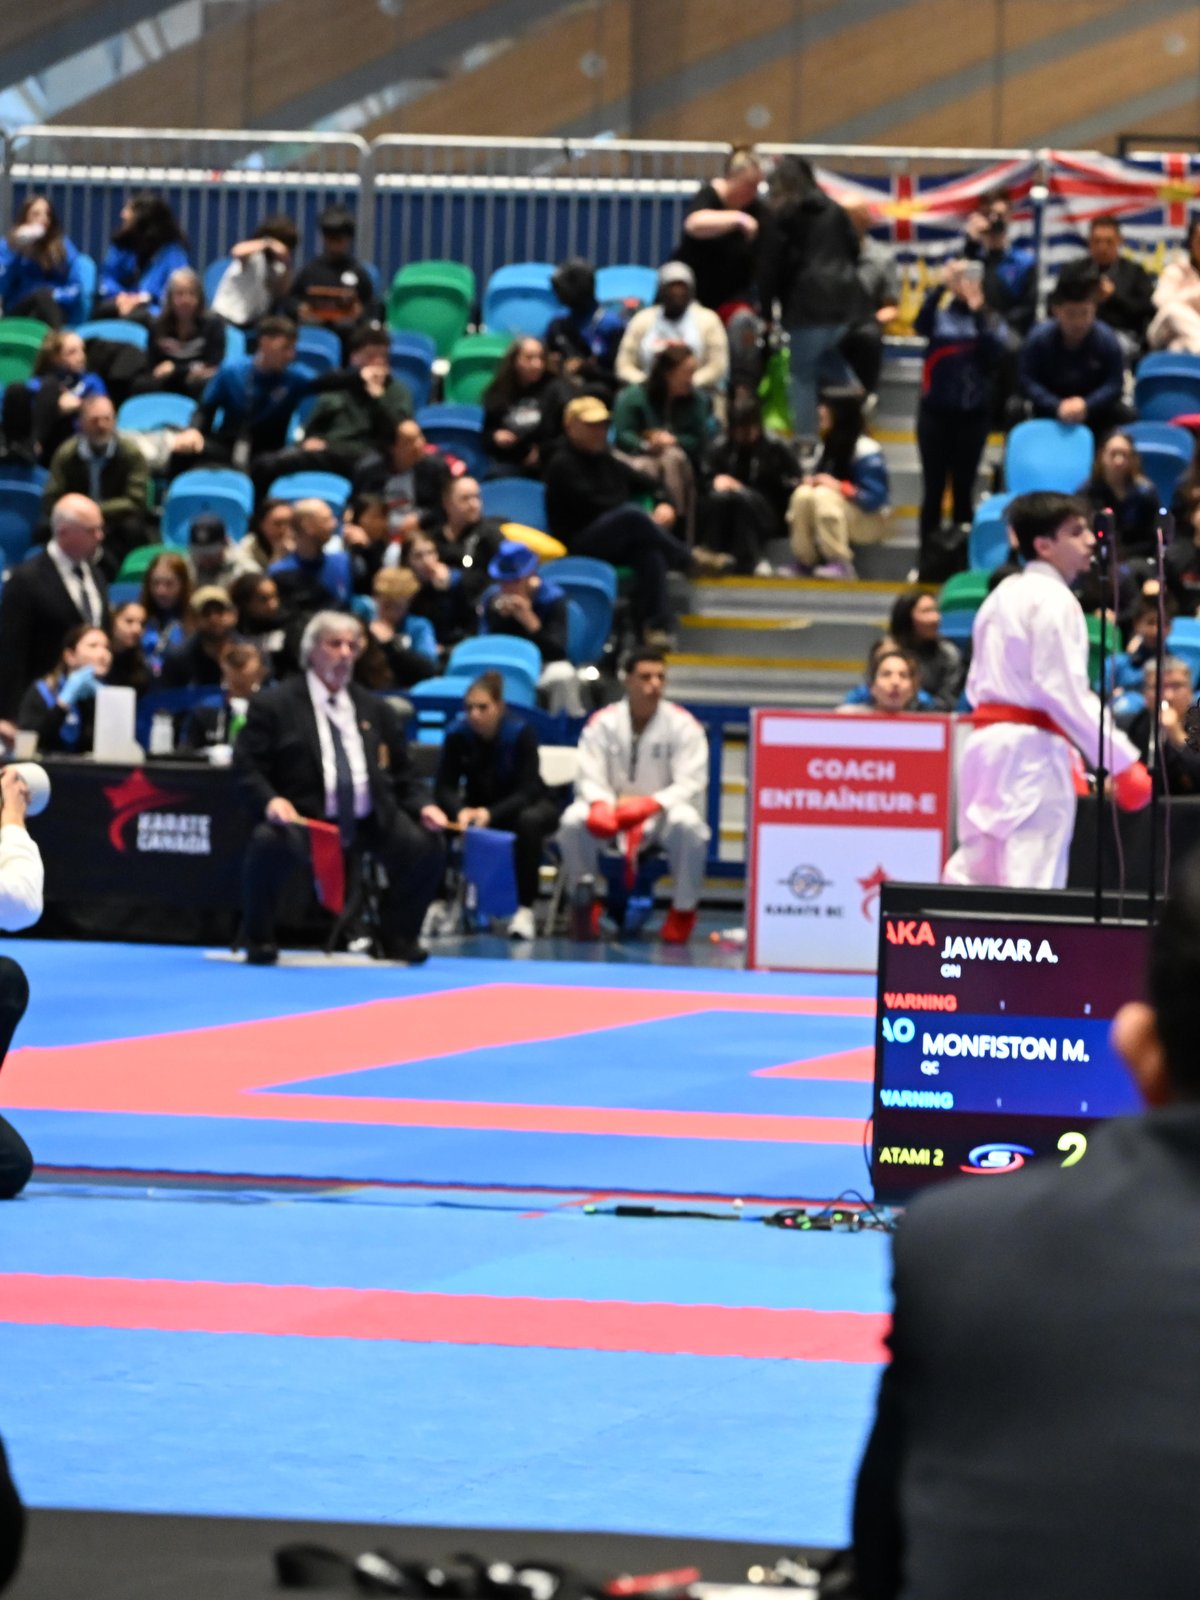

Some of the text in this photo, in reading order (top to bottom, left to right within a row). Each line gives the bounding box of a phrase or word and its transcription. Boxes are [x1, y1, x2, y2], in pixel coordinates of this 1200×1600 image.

[807, 758, 896, 781] COACH
[137, 812, 212, 832] KARATE
[136, 831, 212, 854] CANADA
[941, 935, 1059, 964] JAWKAR A.
[922, 1032, 1090, 1063] MONFISTON M.
[920, 1060, 941, 1076] QC
[879, 1146, 945, 1167] ATAMI 2
